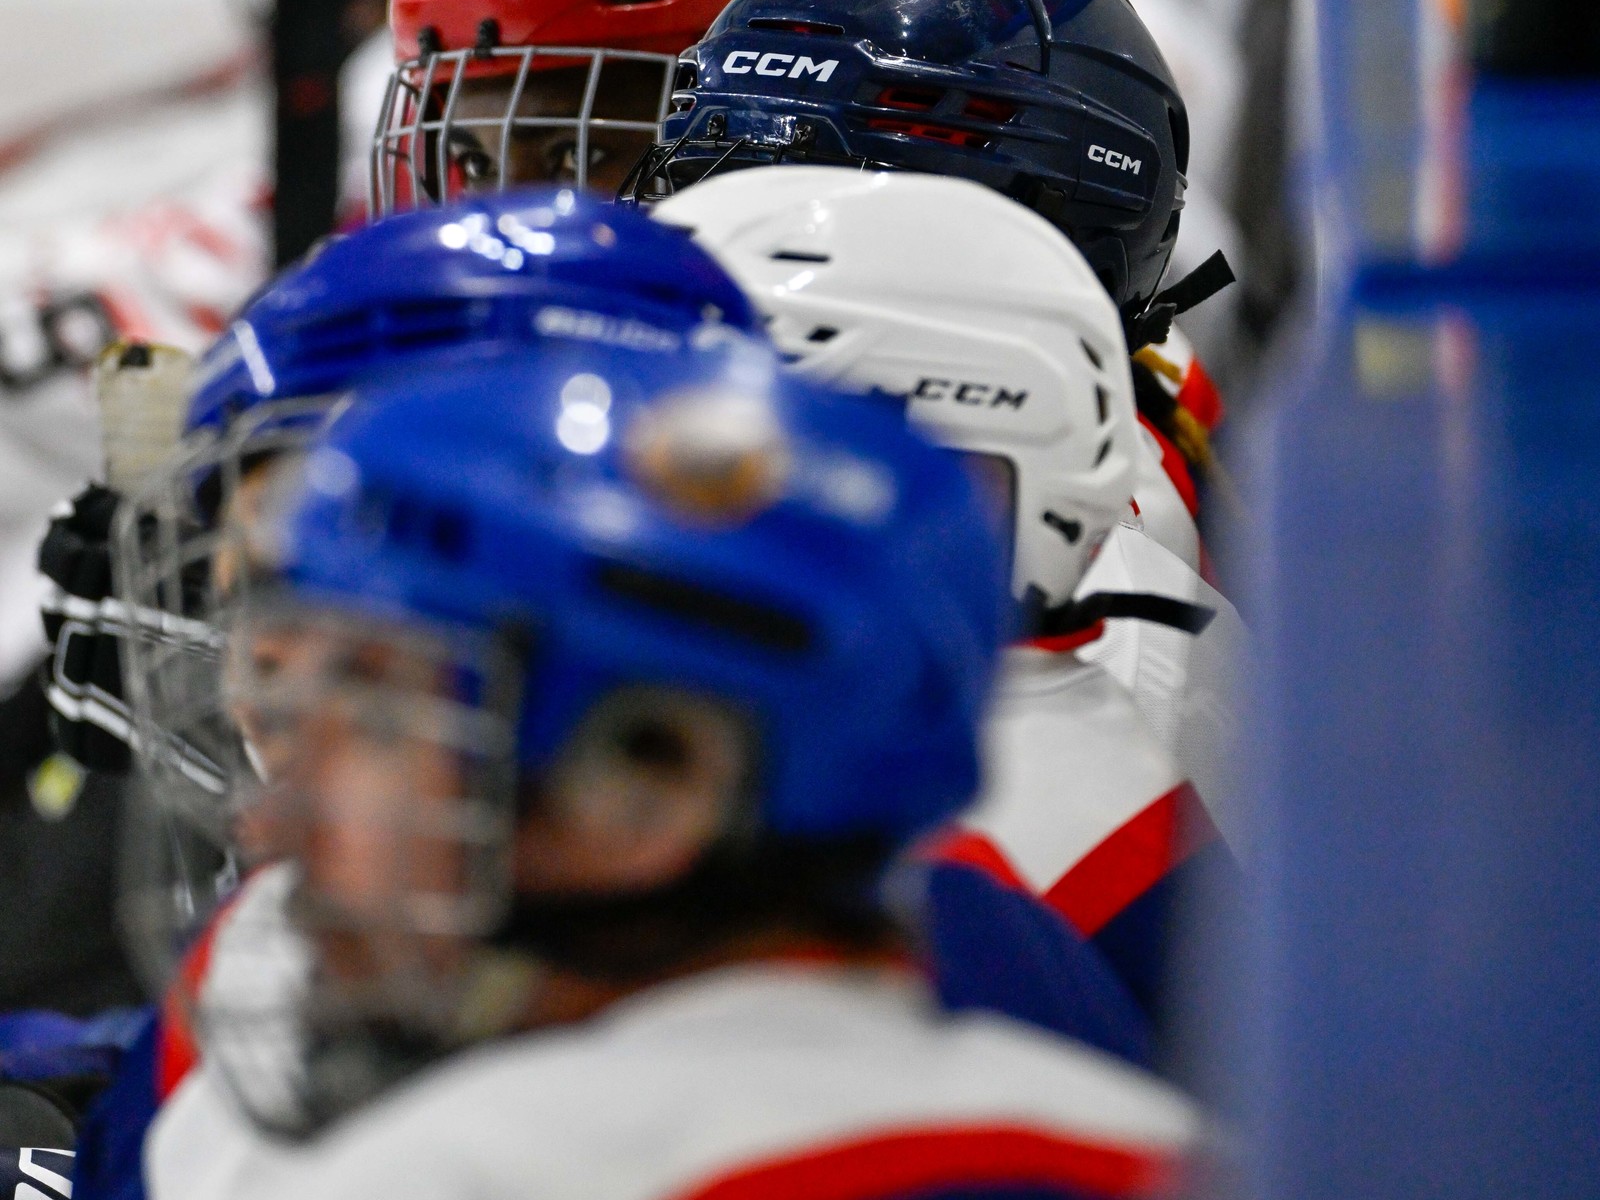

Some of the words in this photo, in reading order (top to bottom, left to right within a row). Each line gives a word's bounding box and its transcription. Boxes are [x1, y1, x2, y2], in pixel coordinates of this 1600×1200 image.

[722, 50, 839, 82] CCM
[1087, 144, 1142, 175] CCM
[911, 377, 1028, 411] CCM
